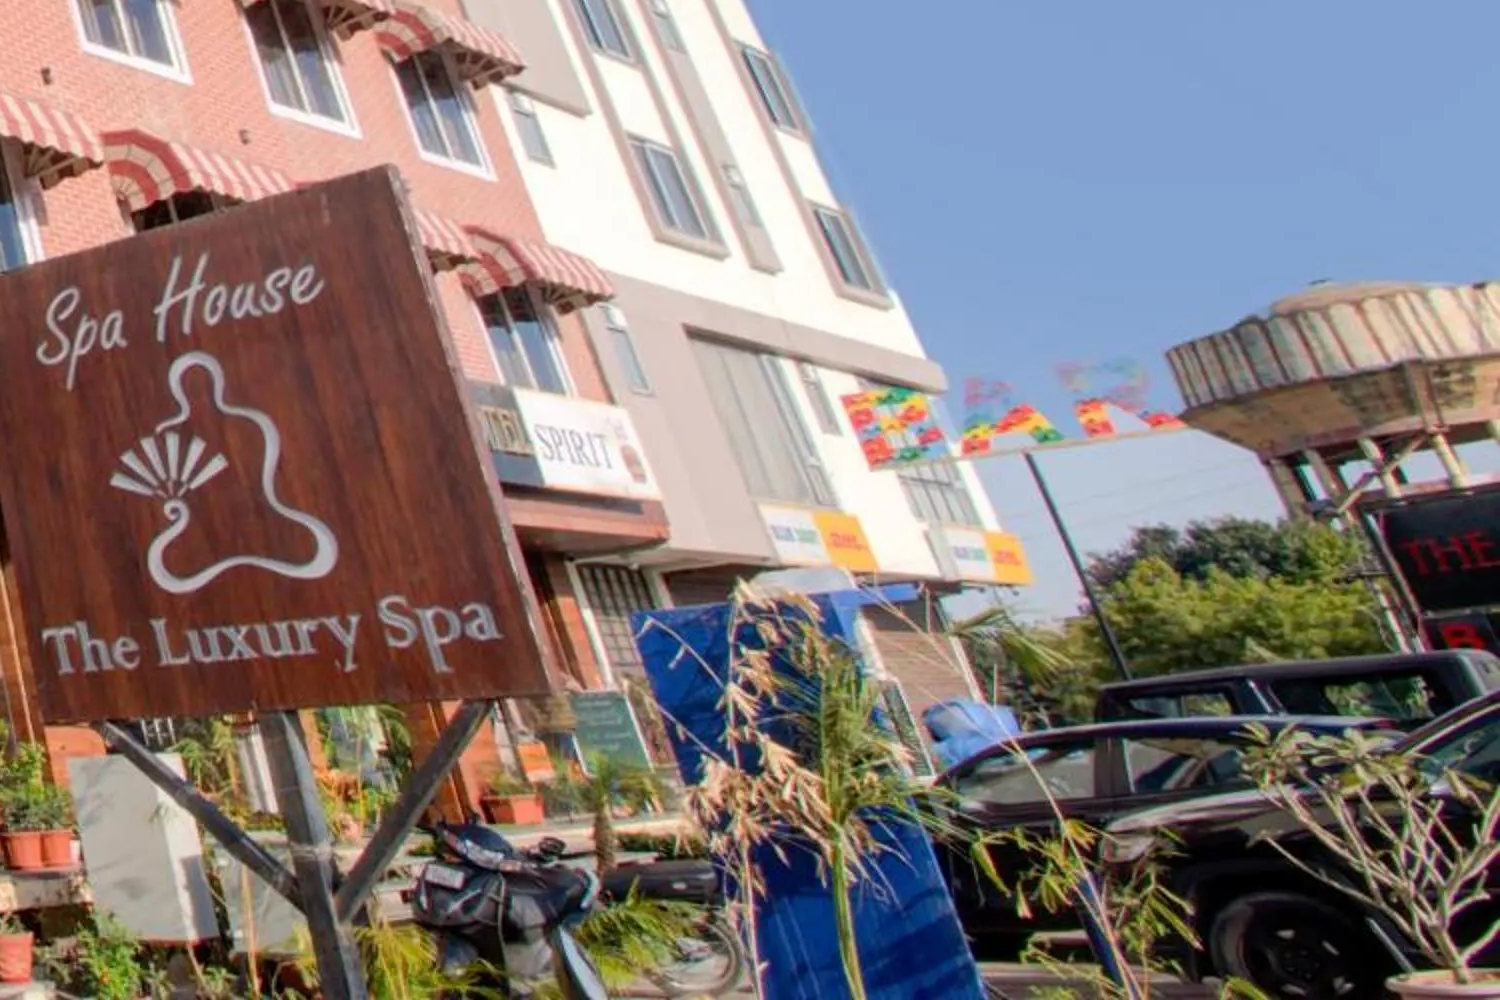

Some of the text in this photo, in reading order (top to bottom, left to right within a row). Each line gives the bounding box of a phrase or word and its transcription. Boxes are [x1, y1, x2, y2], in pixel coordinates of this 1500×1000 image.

[36, 252, 326, 391] Spa House
[534, 424, 614, 470] SPIRIT
[41, 594, 504, 675] The Luxury Spa
